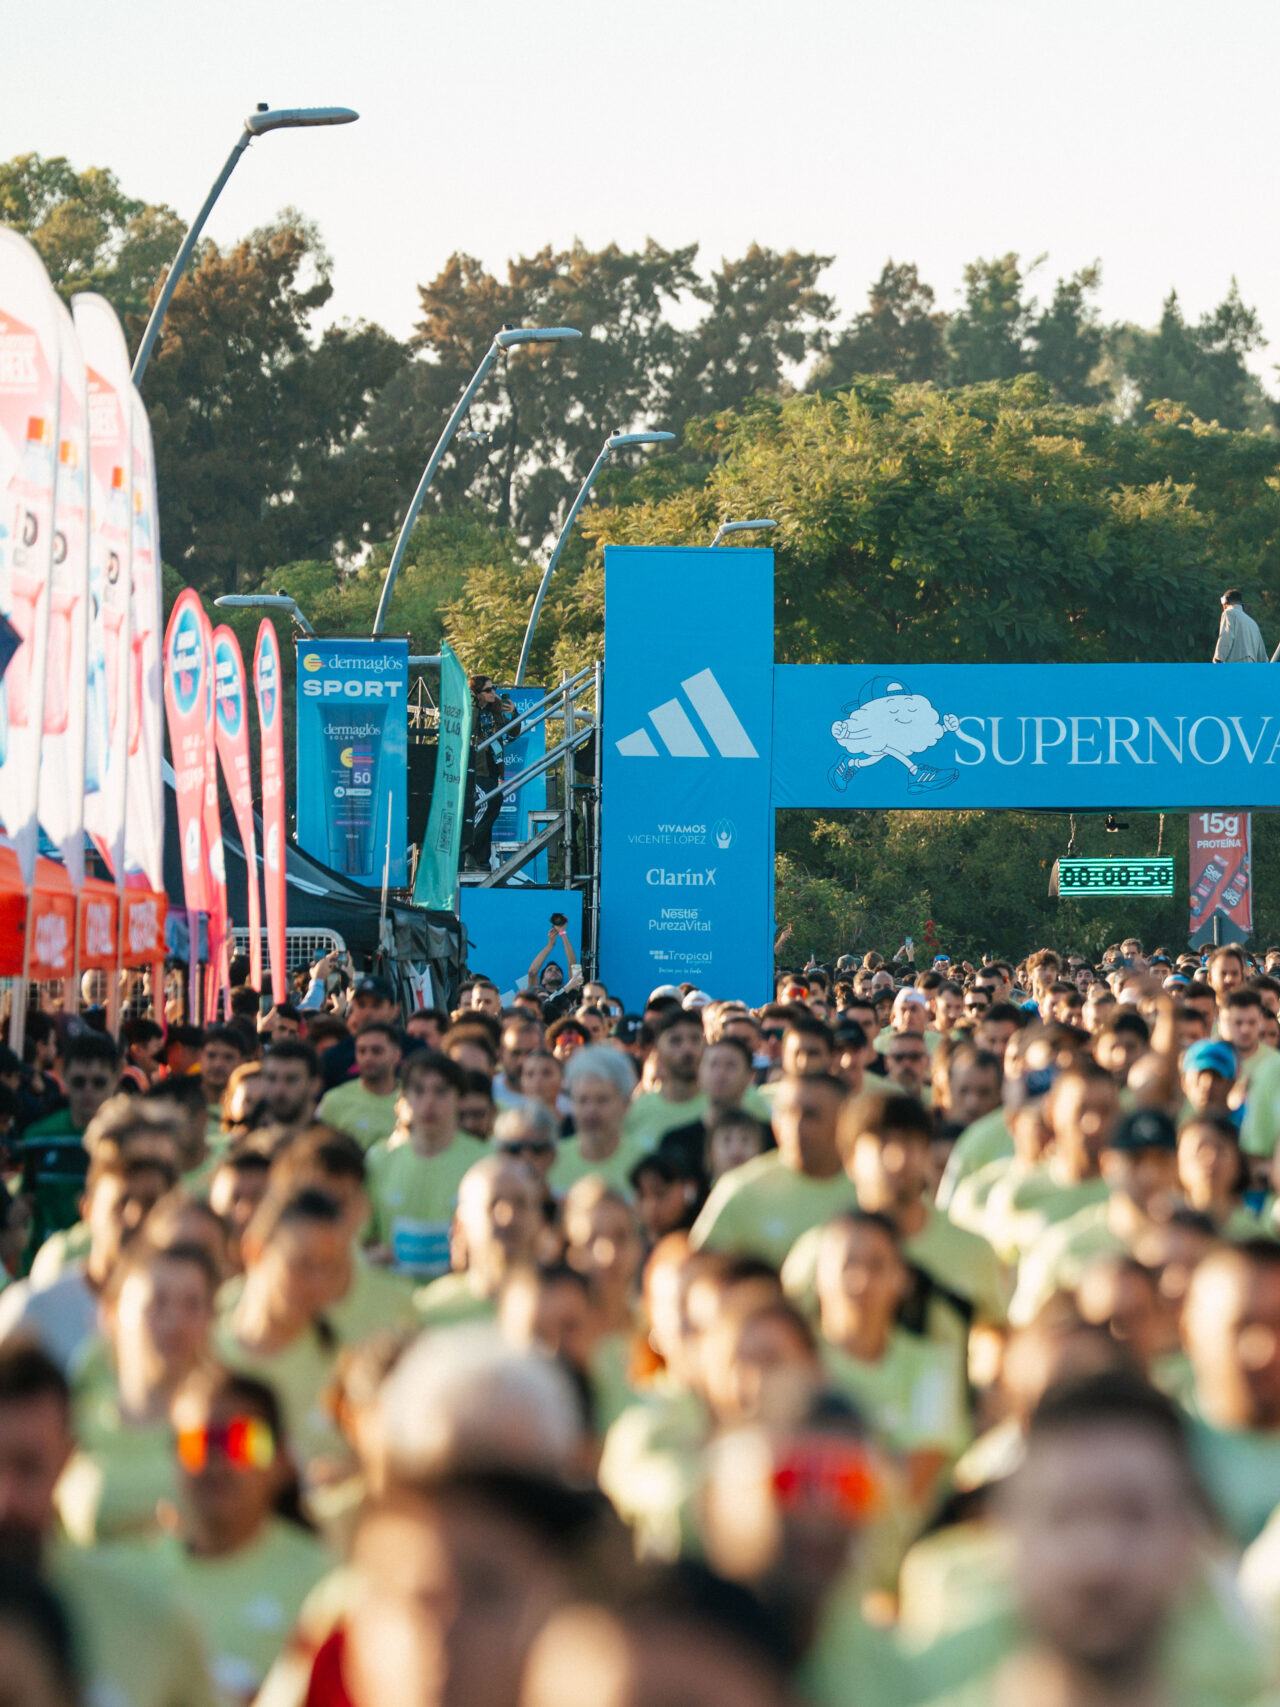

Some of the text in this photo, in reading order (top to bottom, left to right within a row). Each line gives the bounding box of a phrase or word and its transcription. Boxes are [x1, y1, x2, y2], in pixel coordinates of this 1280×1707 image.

[328, 654, 403, 673] dermaglós
[303, 680, 403, 697] SPORT
[323, 723, 382, 738] dermaglós
[353, 772, 371, 784] 50
[658, 825, 706, 833] VIVAMOS
[1200, 813, 1239, 837] 15g
[628, 832, 706, 845] VICENTE LÓPEZ
[1197, 837, 1242, 849] PROTEÍNA
[649, 919, 711, 931] PurezaVital
[669, 950, 712, 965] Tropical
